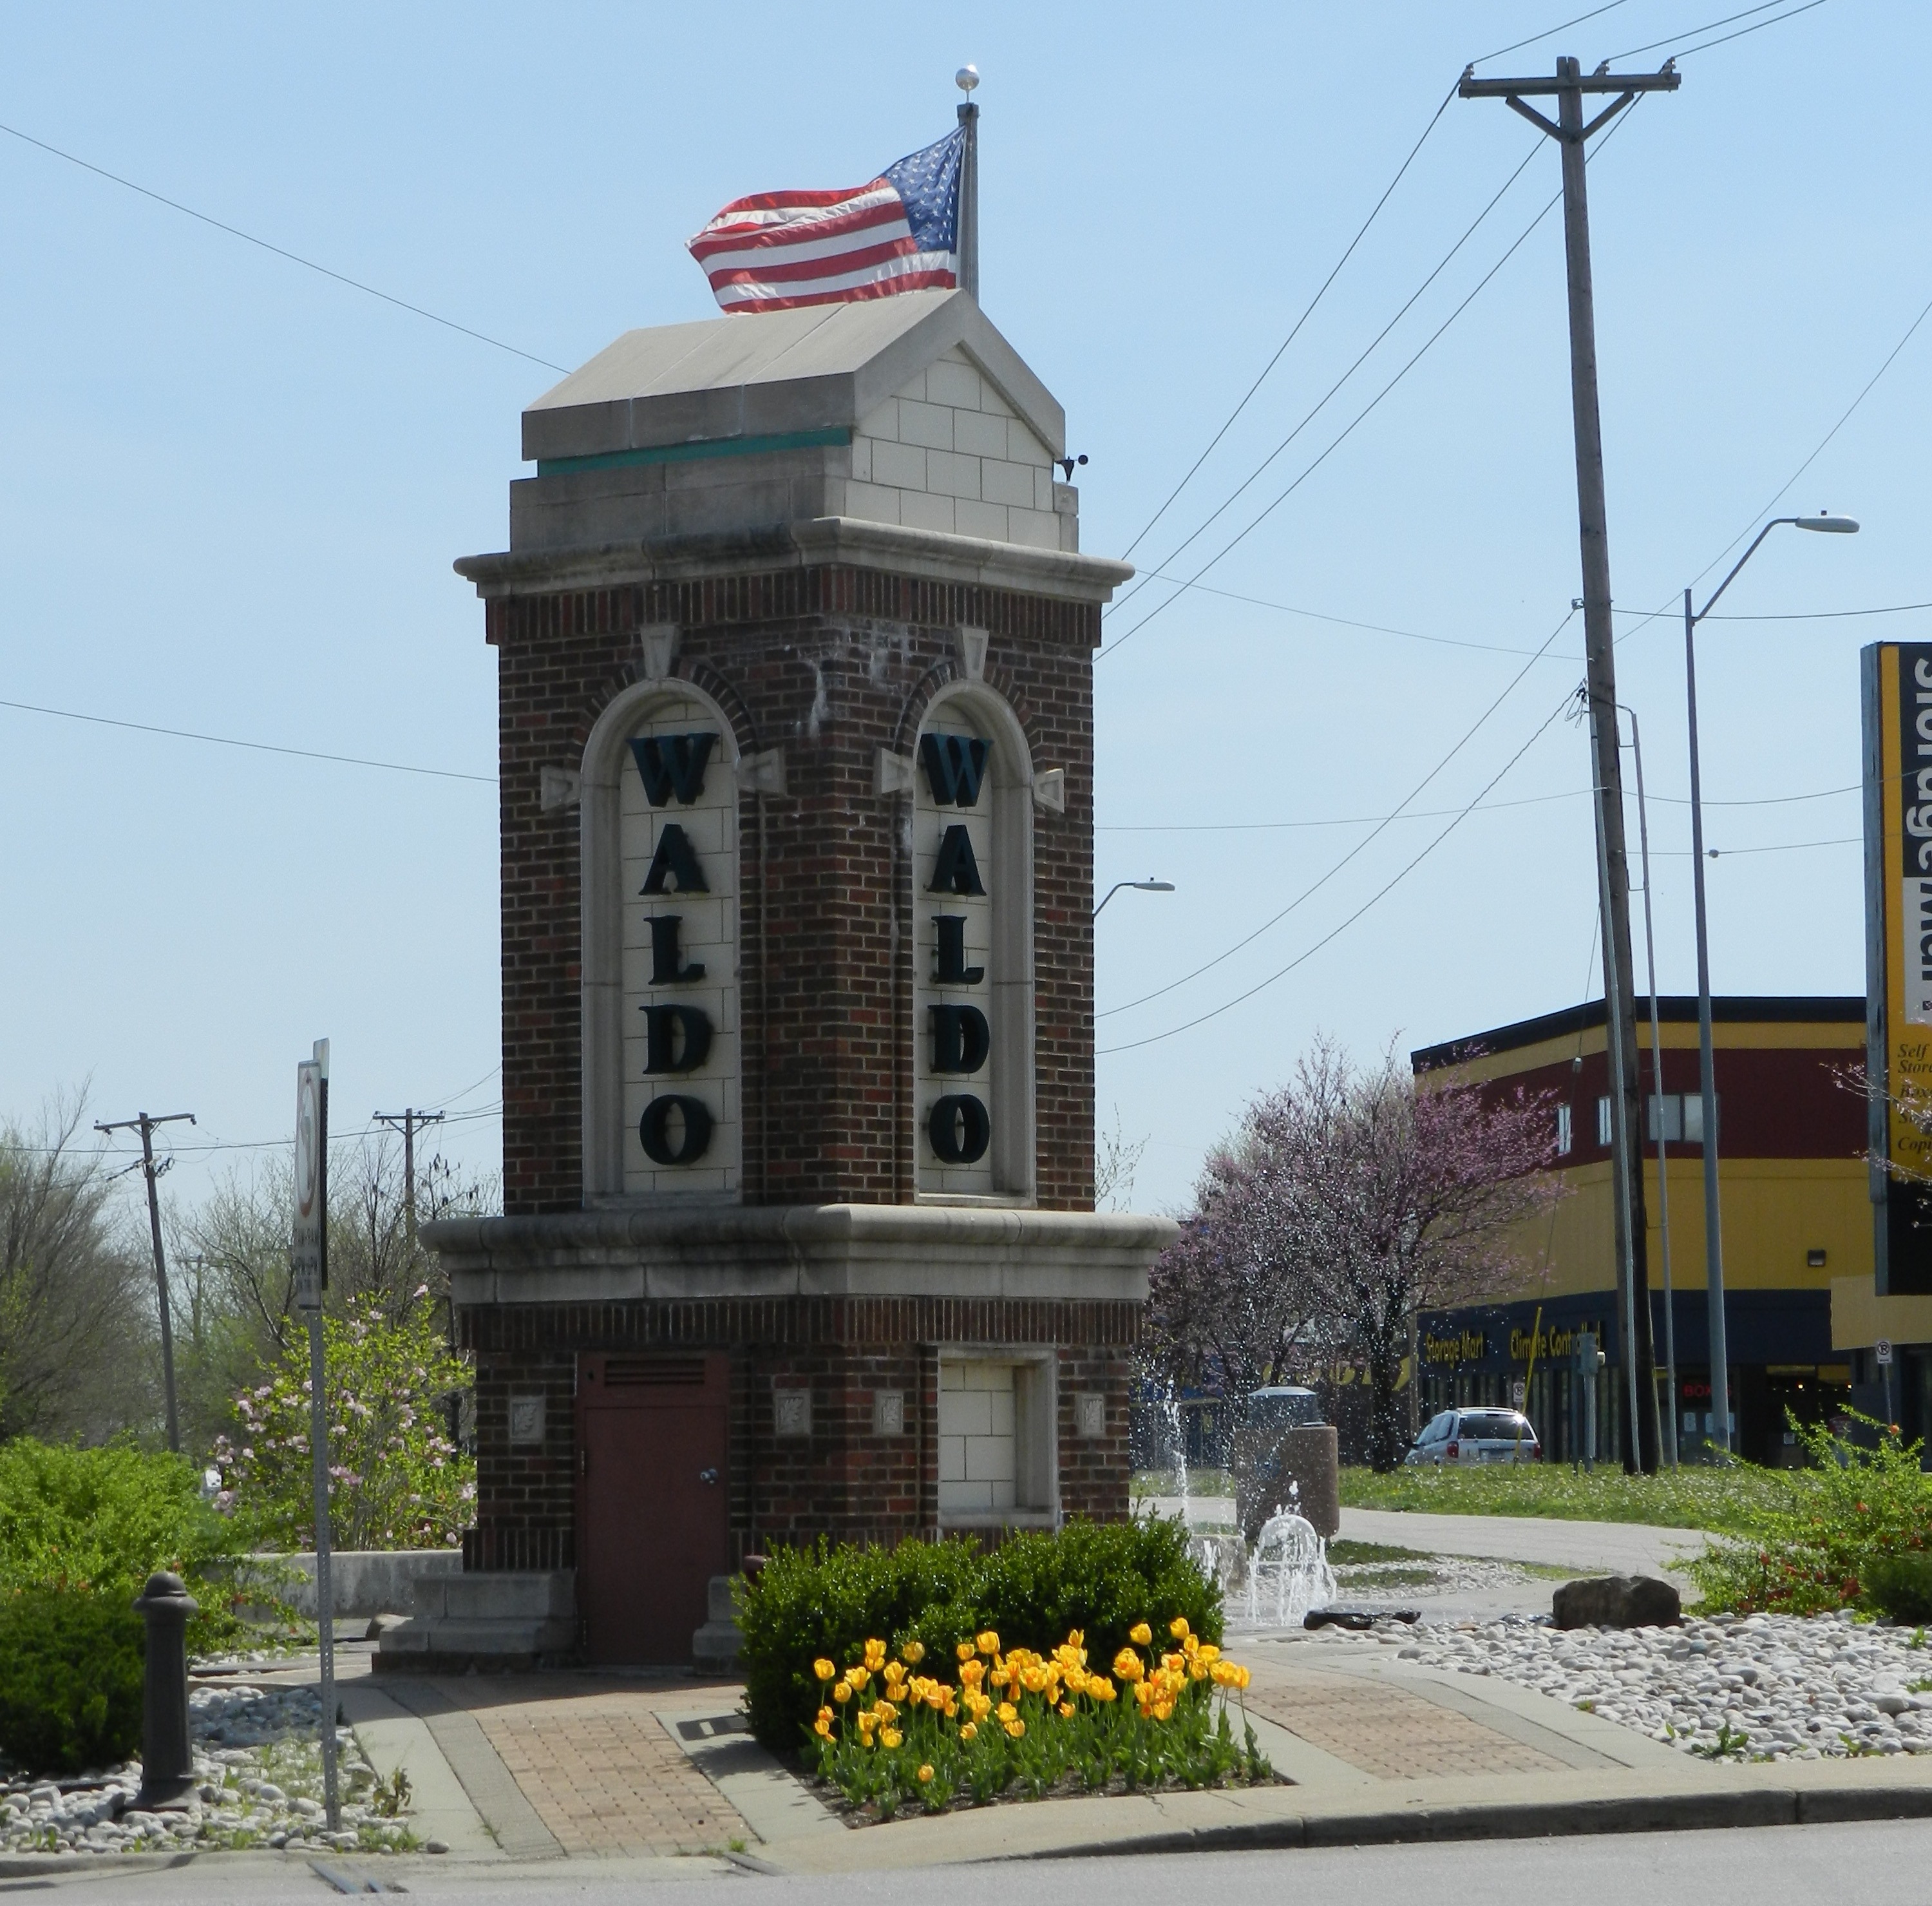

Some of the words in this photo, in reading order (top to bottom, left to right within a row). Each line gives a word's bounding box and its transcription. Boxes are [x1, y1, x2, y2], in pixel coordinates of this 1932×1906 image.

[627, 732, 719, 1165] WALDO
[921, 733, 994, 1164] WALDO
[1897, 1044, 1931, 1062] Self
[1510, 1328, 1546, 1360] Climte
[1683, 1384, 1732, 1398] BOXS
